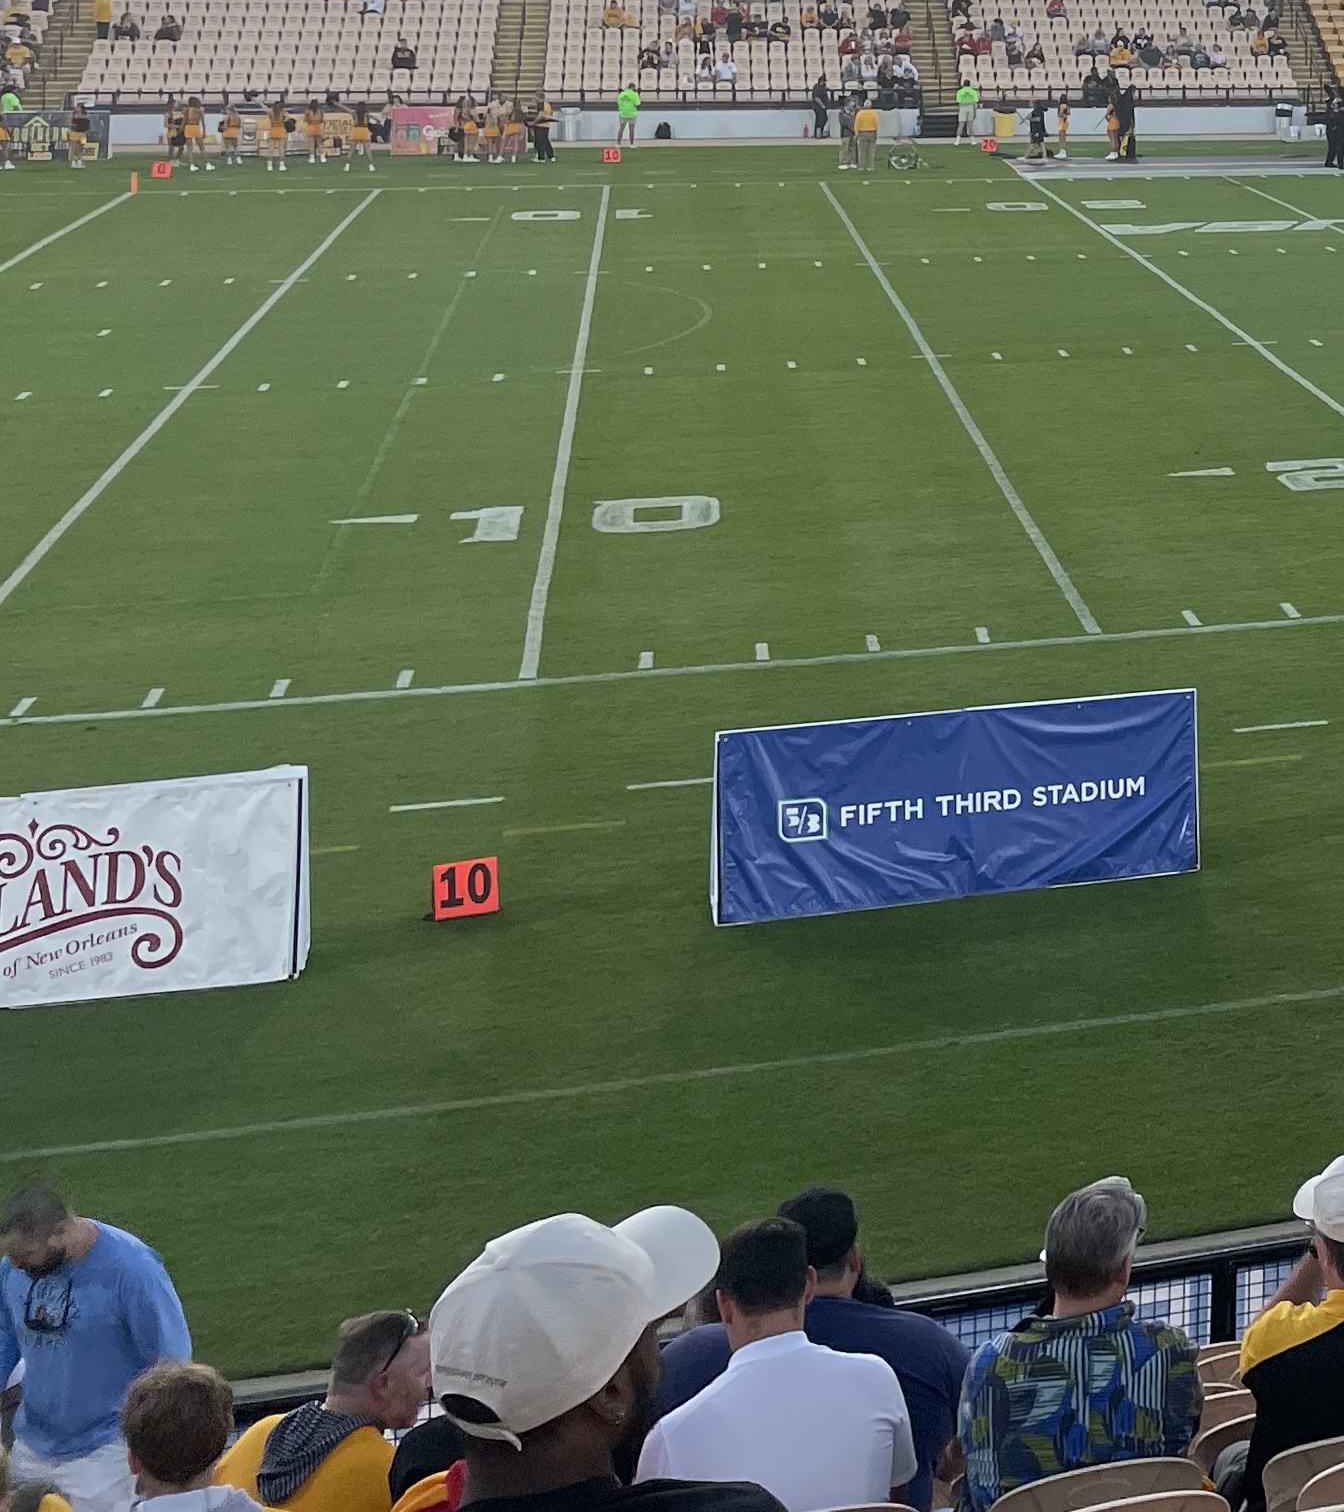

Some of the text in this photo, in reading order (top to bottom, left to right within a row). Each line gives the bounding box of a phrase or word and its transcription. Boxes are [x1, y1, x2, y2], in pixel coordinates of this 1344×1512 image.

[605, 150, 619, 161] 10
[840, 797, 925, 828] FIFTH
[935, 787, 1022, 818] THIRD
[1032, 775, 1147, 807] STADIUM
[439, 862, 492, 909] 10
[3, 922, 139, 979] of New Orleans
[48, 951, 114, 980] SINCE 1983
